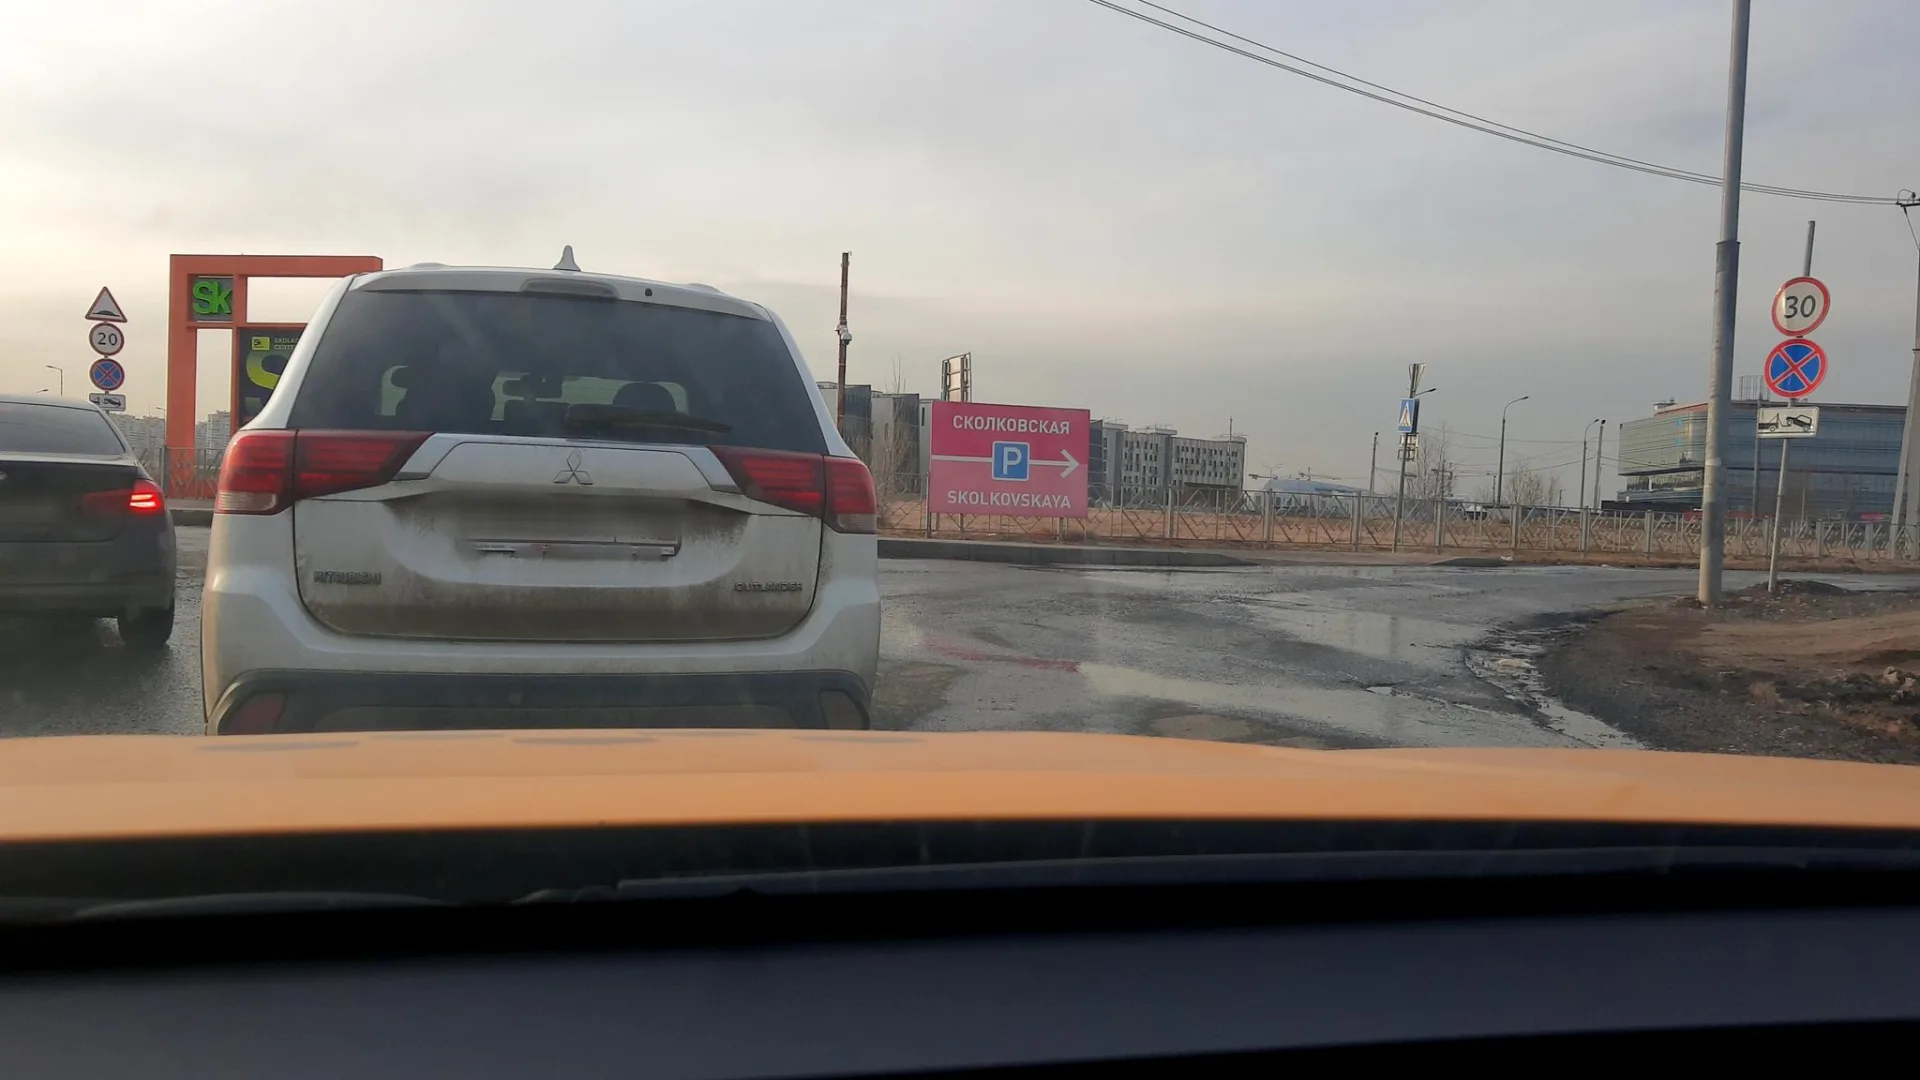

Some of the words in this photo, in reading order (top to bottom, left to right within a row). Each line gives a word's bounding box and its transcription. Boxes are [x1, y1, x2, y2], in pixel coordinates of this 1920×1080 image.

[192, 280, 233, 314] Sk
[1784, 295, 1816, 319] 30
[97, 332, 118, 346] 20
[953, 415, 1070, 434] СКОЛКОВСКАЯ
[1003, 447, 1022, 475] P
[947, 490, 1071, 508] SKOLKOVSKAYA
